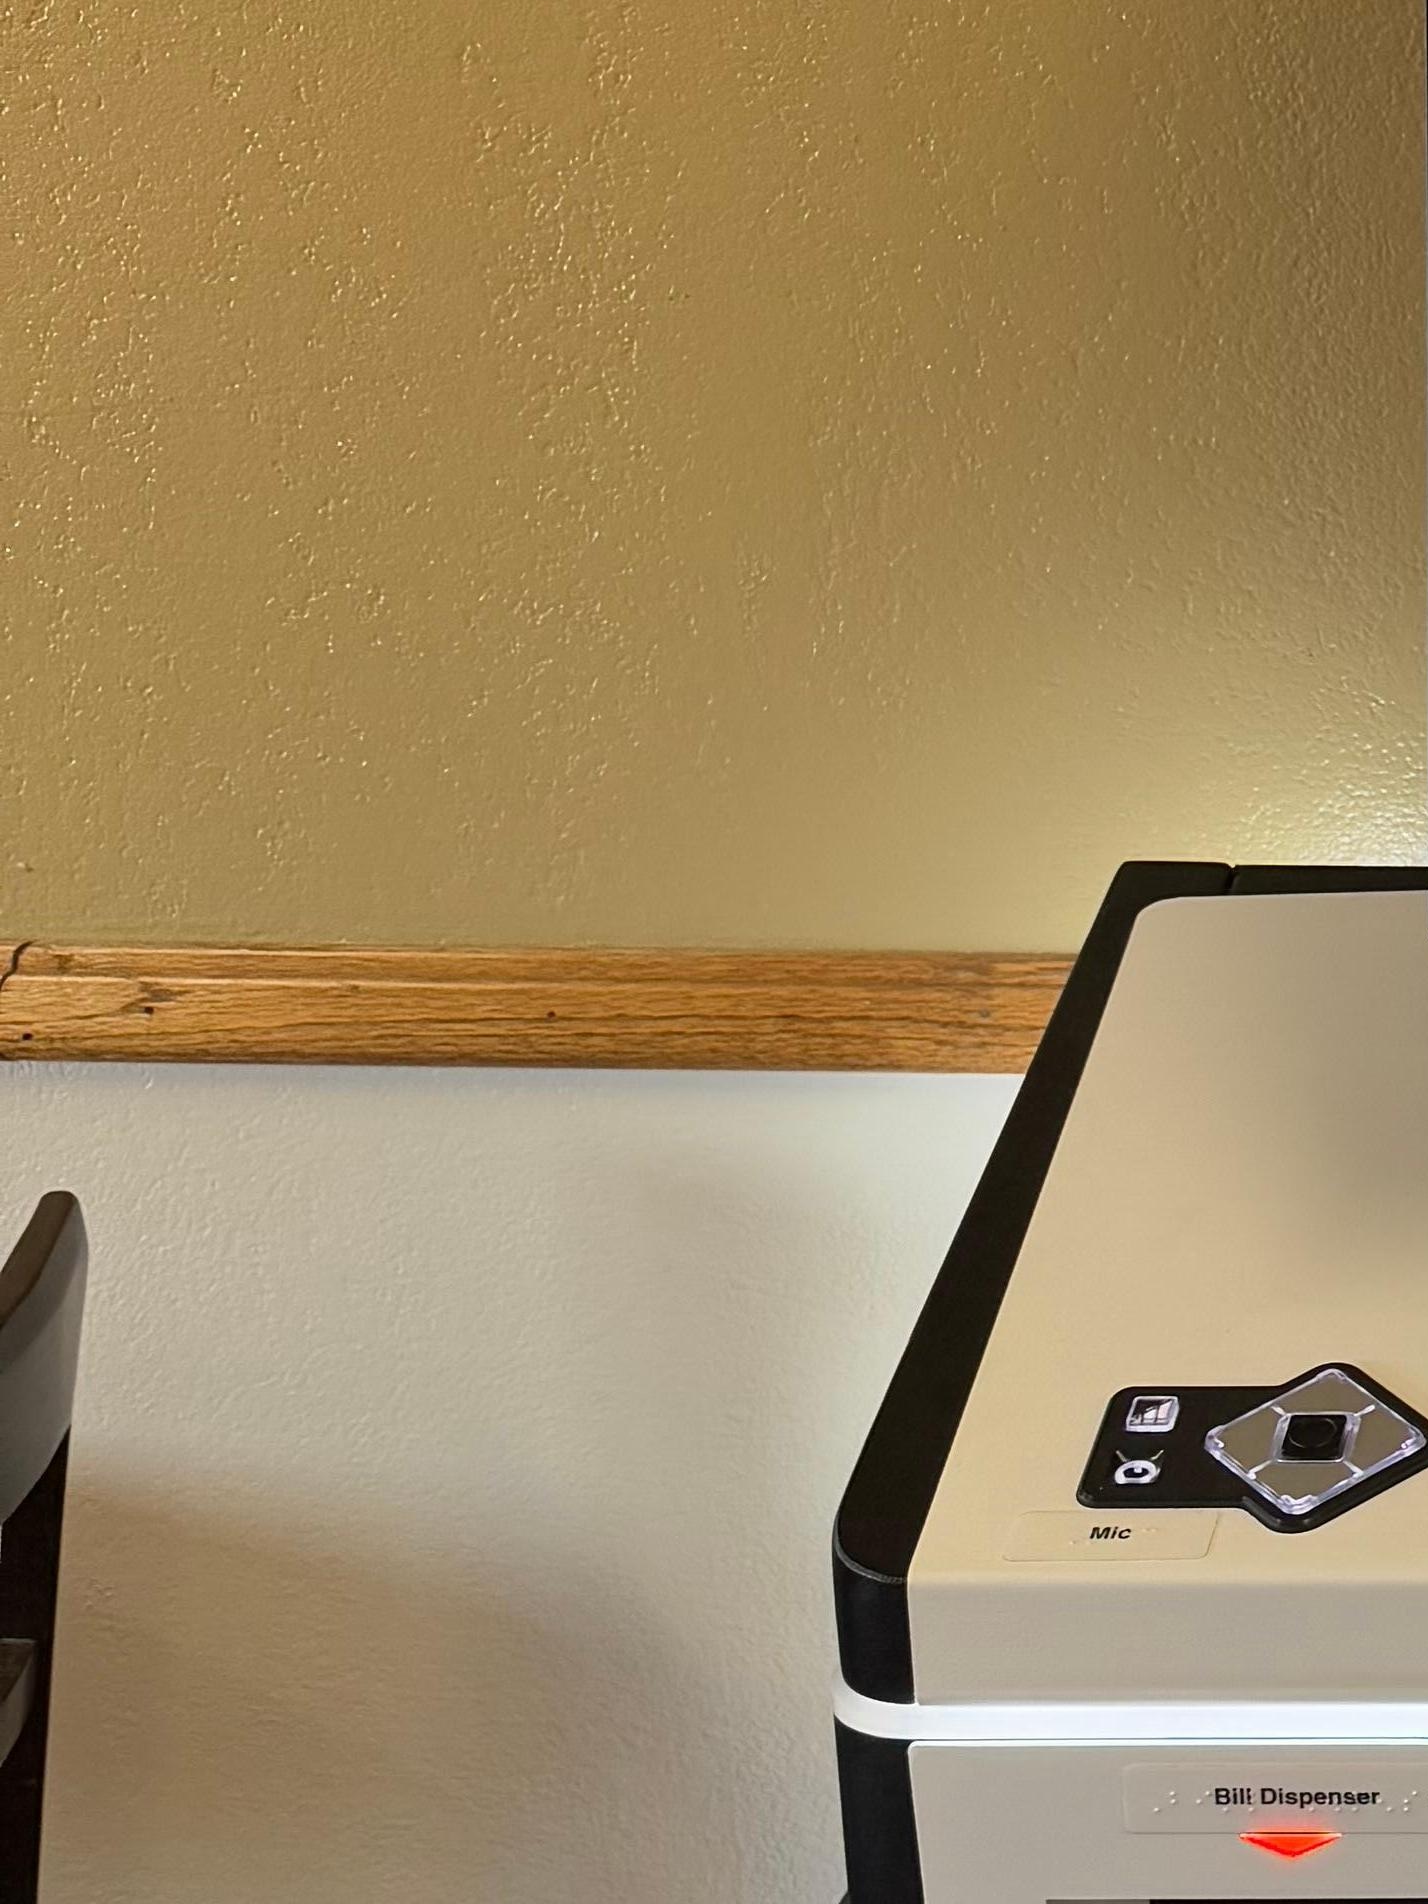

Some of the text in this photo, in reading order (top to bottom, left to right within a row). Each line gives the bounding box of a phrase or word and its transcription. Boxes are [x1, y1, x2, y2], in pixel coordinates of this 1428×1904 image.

[1090, 1526, 1132, 1540] Mic
[1214, 1787, 1380, 1810] Bill Dispenser
